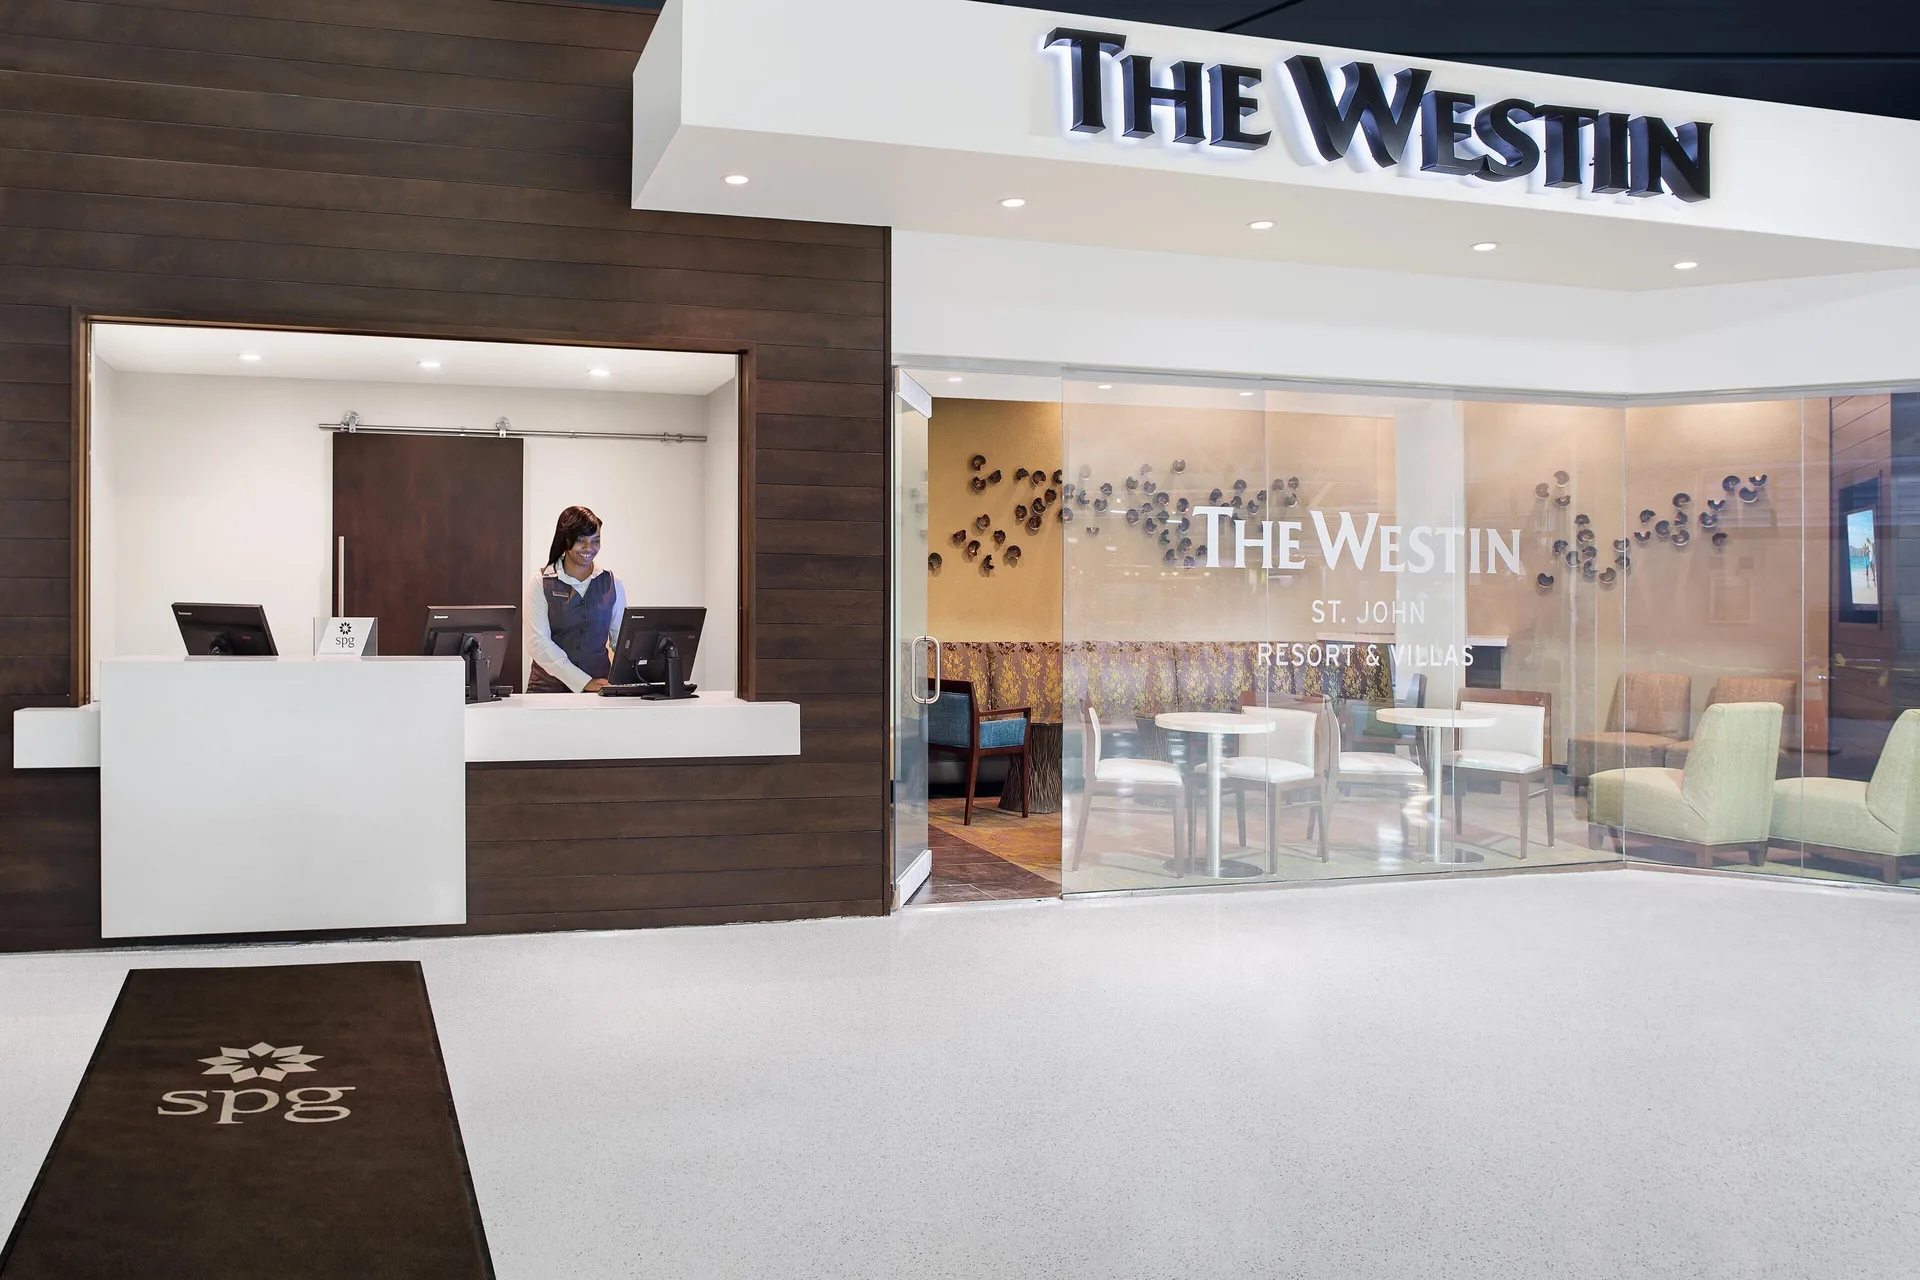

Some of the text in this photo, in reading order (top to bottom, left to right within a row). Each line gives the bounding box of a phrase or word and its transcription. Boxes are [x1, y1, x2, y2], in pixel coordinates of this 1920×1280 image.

[1044, 26, 1714, 203] THE WESTIN
[1192, 506, 1523, 575] THE WESTIN
[1311, 600, 1425, 625] ST. JOHN
[335, 636, 356, 649] spg
[1257, 643, 1474, 668] RESORT & VILLAS
[157, 1086, 356, 1125] spg
